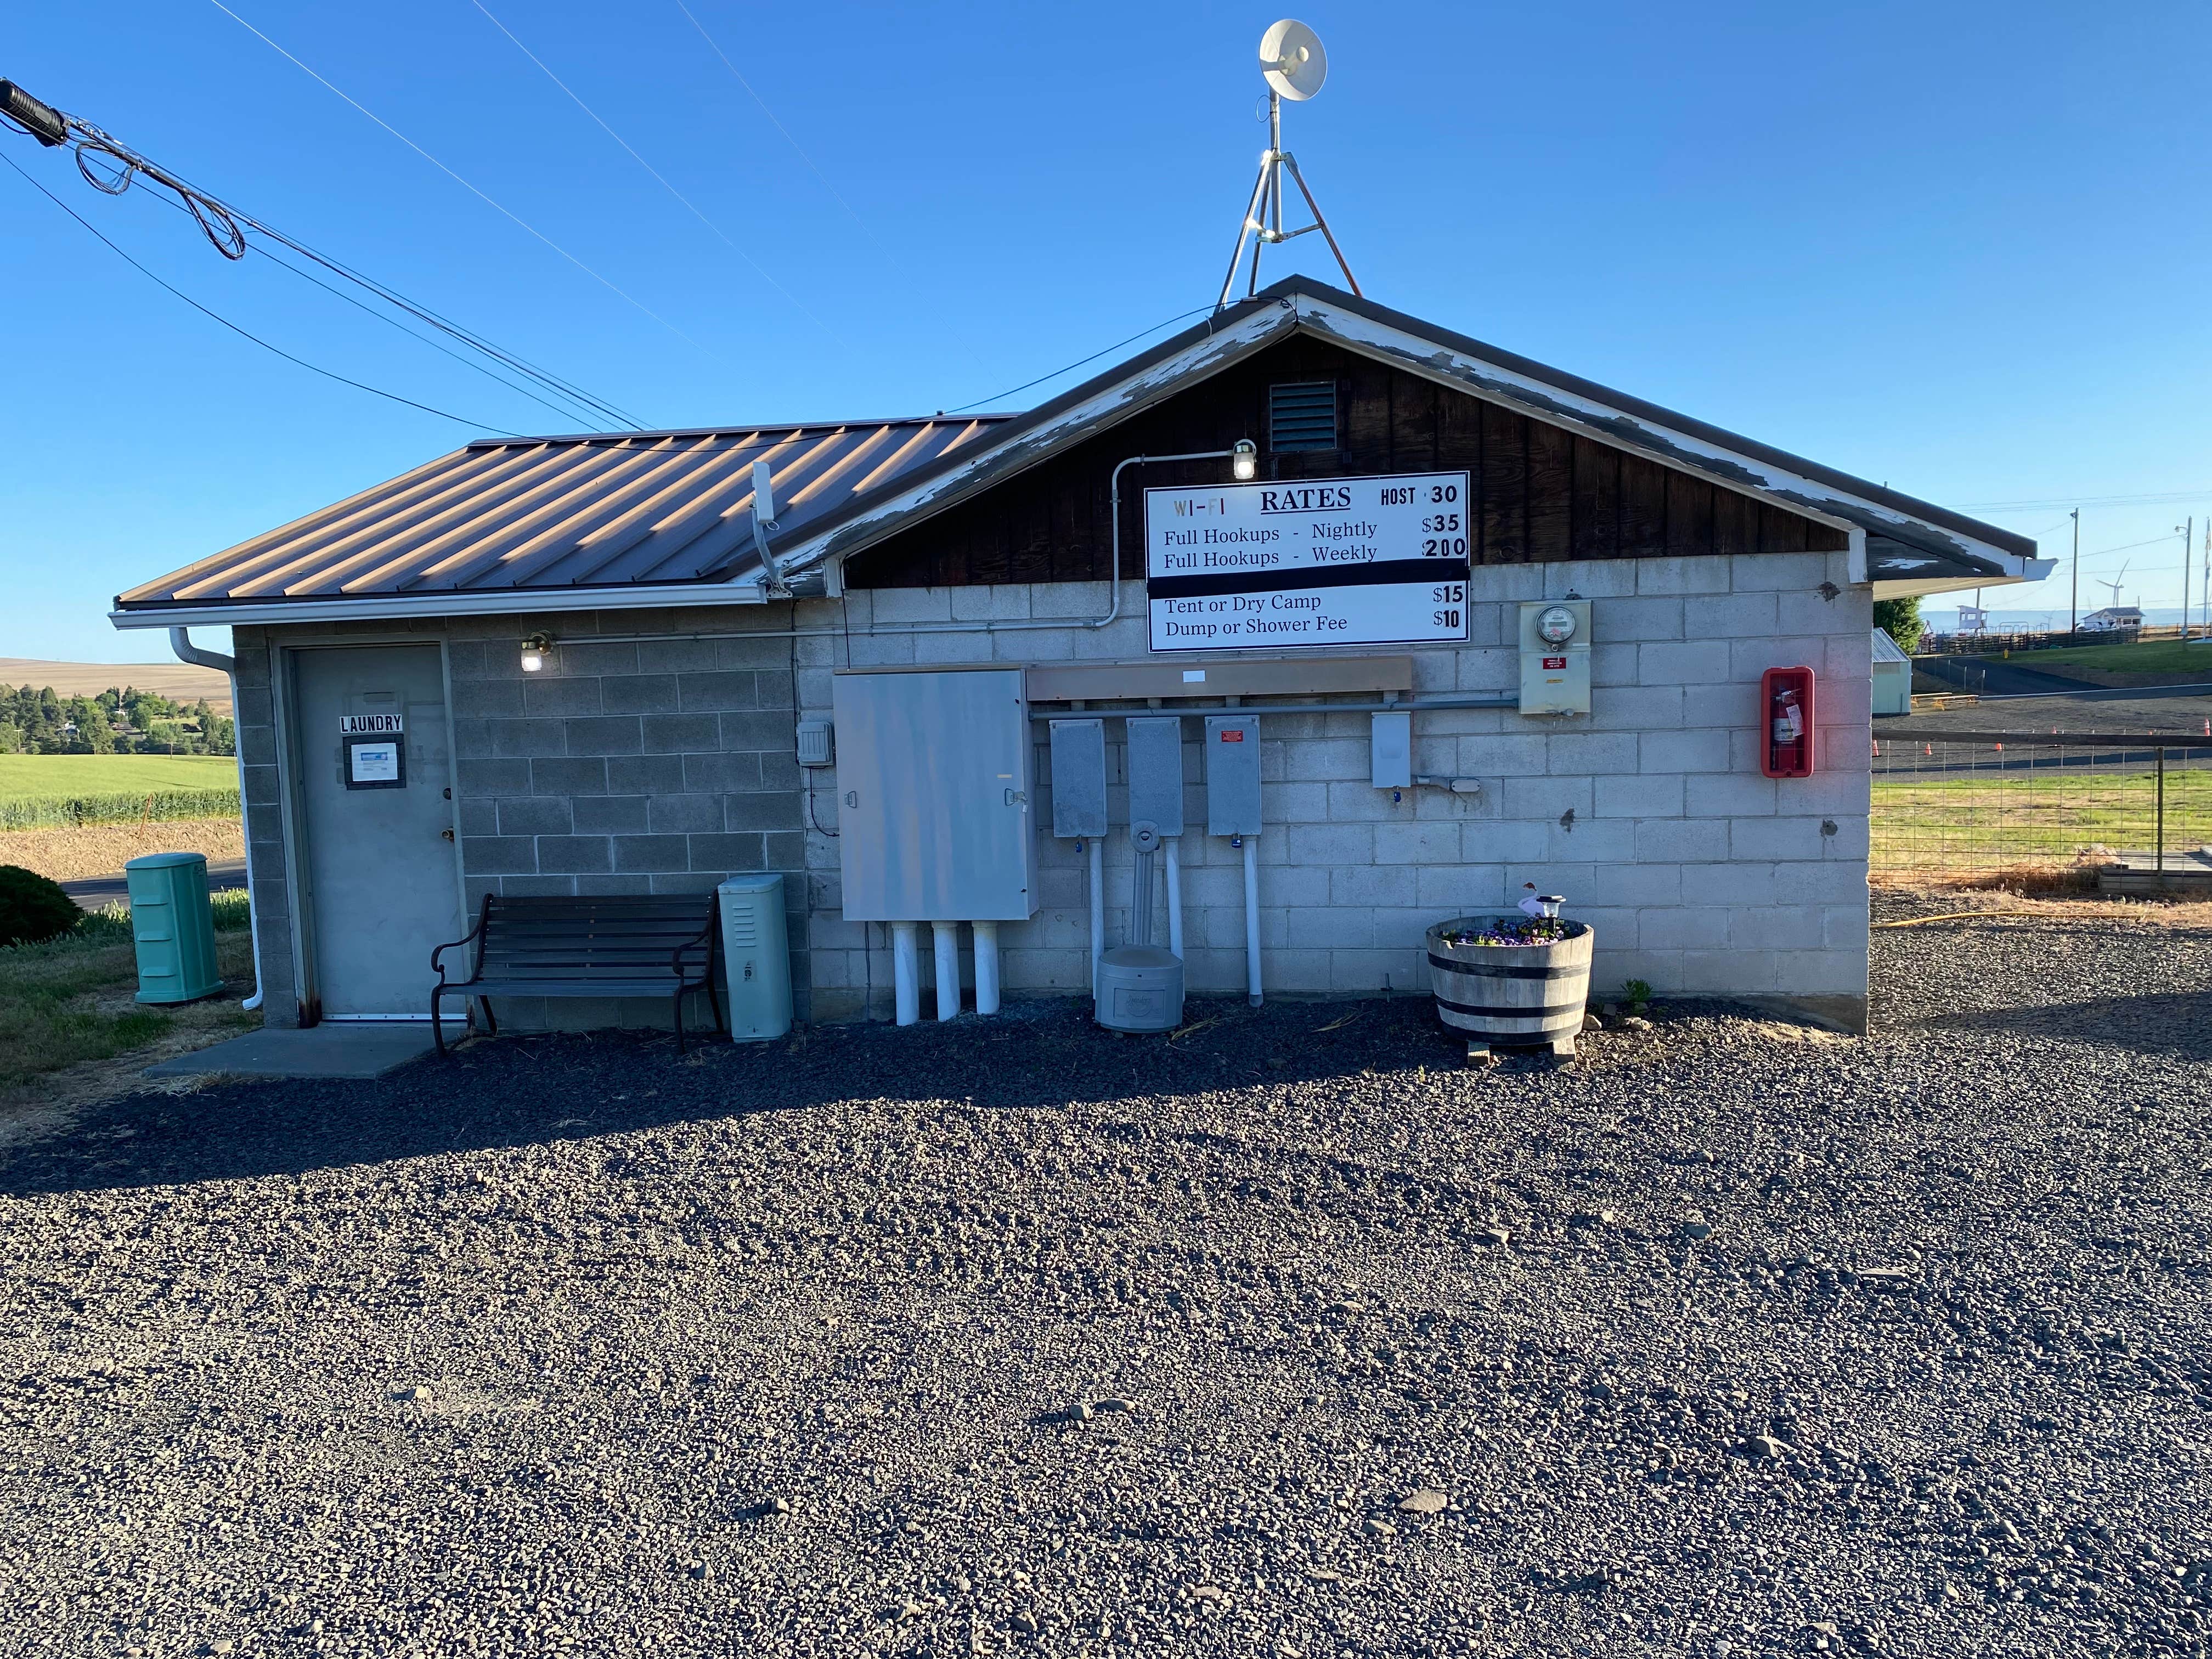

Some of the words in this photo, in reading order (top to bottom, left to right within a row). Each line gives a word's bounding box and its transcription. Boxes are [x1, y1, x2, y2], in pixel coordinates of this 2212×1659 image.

[1261, 487, 1351, 511] RATES
[1381, 487, 1416, 505] HOST
[1431, 486, 1457, 503] 30
[1164, 530, 1198, 545] Full
[1204, 528, 1279, 544] Hookups
[1312, 521, 1378, 540] Nightly
[1422, 514, 1459, 533] $35
[1164, 553, 1198, 568] Full
[1204, 551, 1279, 567] Hookups
[1312, 545, 1378, 562] Weekly
[1165, 600, 1204, 613] Tent
[1209, 601, 1227, 612] or
[1232, 596, 1265, 613] Dry
[1271, 595, 1321, 611] Camp
[1433, 585, 1463, 602] $15
[1166, 622, 1217, 637] Dump
[1223, 623, 1240, 634] or
[1246, 619, 1311, 633] Shower
[1316, 616, 1347, 630] Fee
[1434, 610, 1459, 628] $10
[341, 715, 401, 732] LAUNDRY
